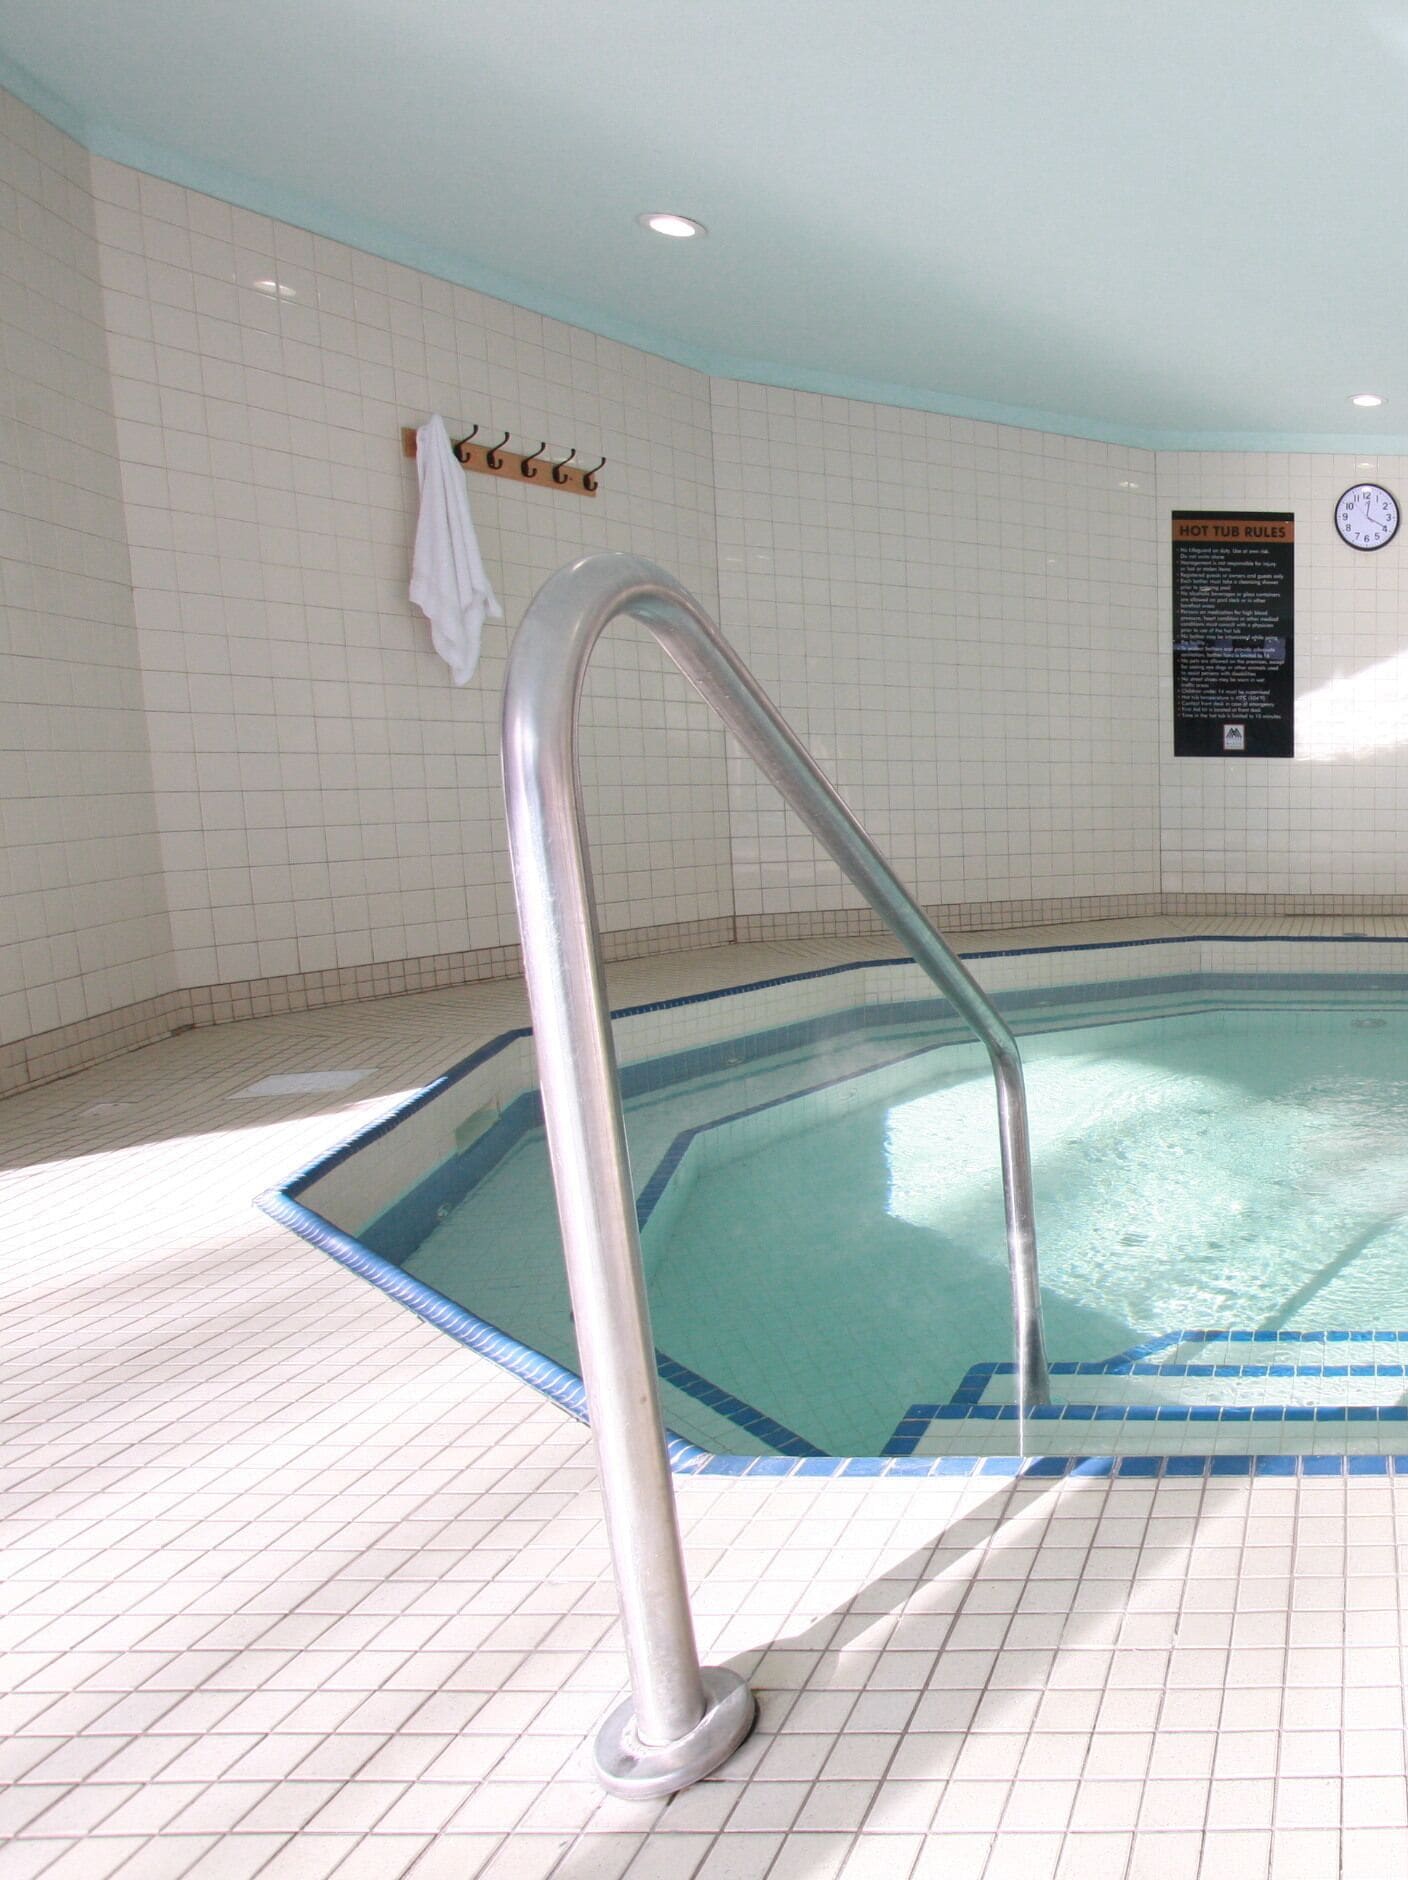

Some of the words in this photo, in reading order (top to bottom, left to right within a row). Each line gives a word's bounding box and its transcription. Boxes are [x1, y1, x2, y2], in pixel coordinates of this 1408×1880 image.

[1383, 502, 1388, 510] 2
[1342, 513, 1348, 521] 9
[1180, 525, 1209, 537] HOT
[1213, 526, 1239, 537] TUB
[1245, 527, 1286, 538] RULES
[1346, 524, 1351, 532] 8
[1355, 532, 1360, 540] 7
